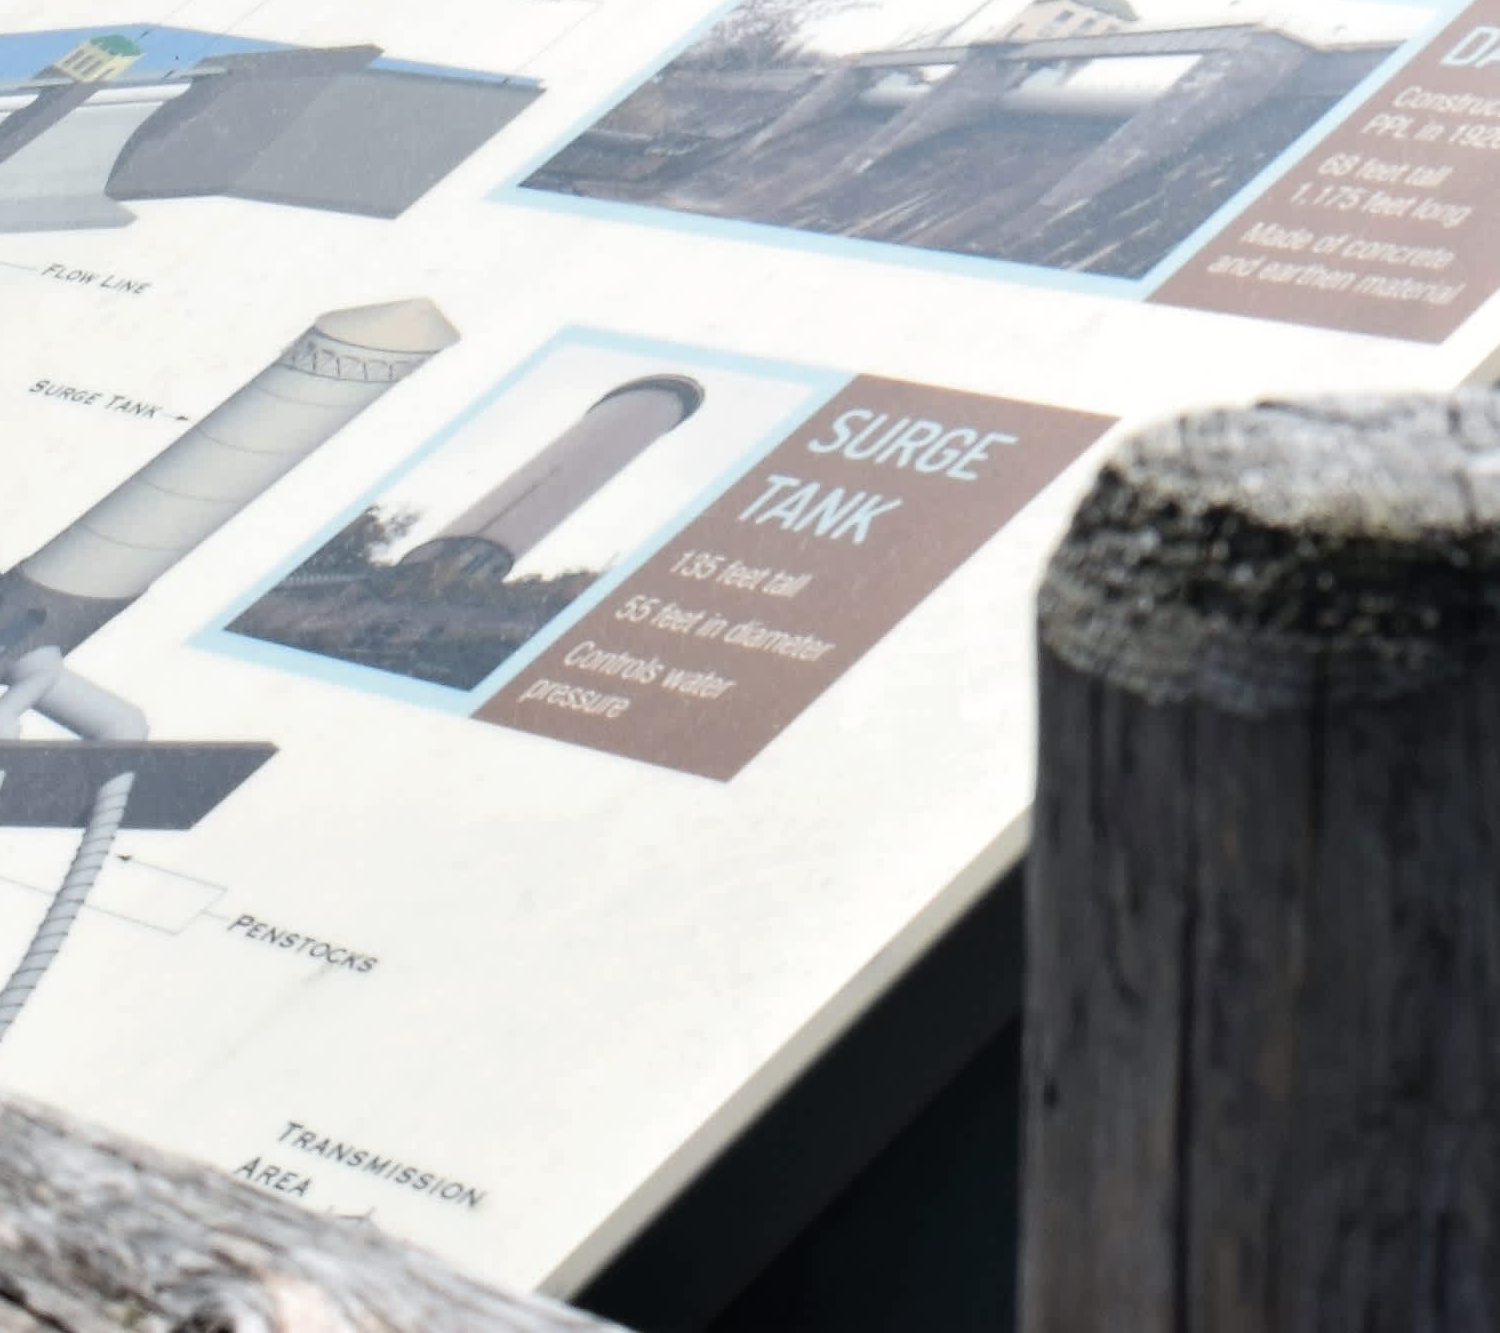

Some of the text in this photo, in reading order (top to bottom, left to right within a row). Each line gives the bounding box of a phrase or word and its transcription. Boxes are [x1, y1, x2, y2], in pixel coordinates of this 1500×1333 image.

[1414, 119, 1444, 141] in
[1355, 158, 1410, 184] feet
[1404, 167, 1453, 187] tall
[1361, 191, 1417, 217] feet
[1410, 197, 1473, 229] long
[1240, 222, 1455, 271] Made of concrete
[41, 263, 151, 295] FLOW LINE
[1207, 255, 1466, 306] and earthen material
[28, 380, 162, 418] SURGE TANK
[808, 410, 1020, 480] SURGE
[737, 475, 903, 545] TANK
[670, 551, 812, 597] 135 feet tall
[615, 595, 835, 661] 55 feet in diameter
[564, 641, 736, 699] Controls water
[518, 679, 630, 719] pressure
[227, 914, 379, 974] PENSTOCKS
[235, 1155, 313, 1198] AREA
[277, 1122, 488, 1209] TRANSMISSION
